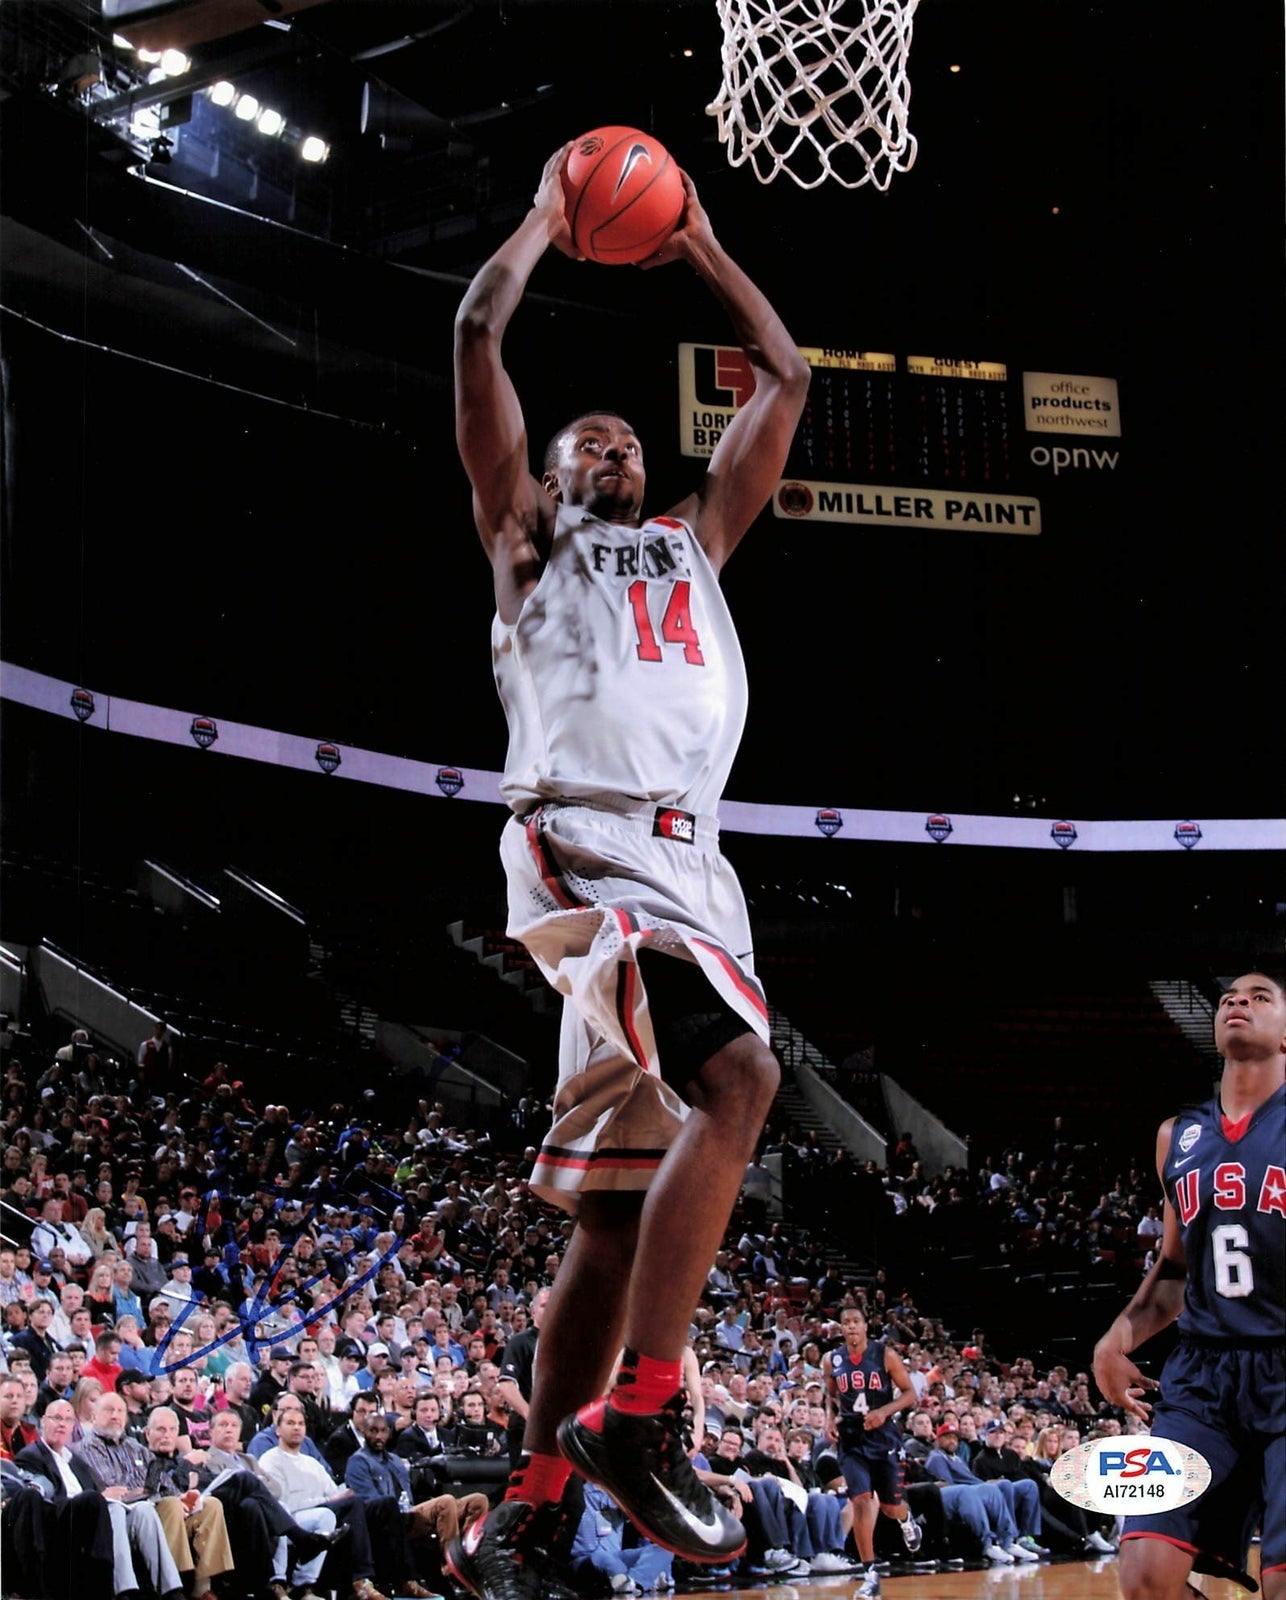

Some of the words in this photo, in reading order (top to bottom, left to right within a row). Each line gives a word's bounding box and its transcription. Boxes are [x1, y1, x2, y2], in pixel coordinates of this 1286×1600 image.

[823, 347, 867, 360] HOME
[934, 357, 979, 369] GUEST
[1050, 381, 1091, 396] office
[1031, 396, 1112, 412] products
[1036, 414, 1109, 428] northwest
[1030, 446, 1120, 476] opnw
[818, 491, 935, 519] MILLER
[945, 500, 1036, 526] PAINT
[628, 579, 706, 667] 14
[1174, 1161, 1286, 1228] USA
[1211, 1224, 1255, 1299] 6
[836, 1370, 882, 1393] USA
[852, 1392, 870, 1415] 4
